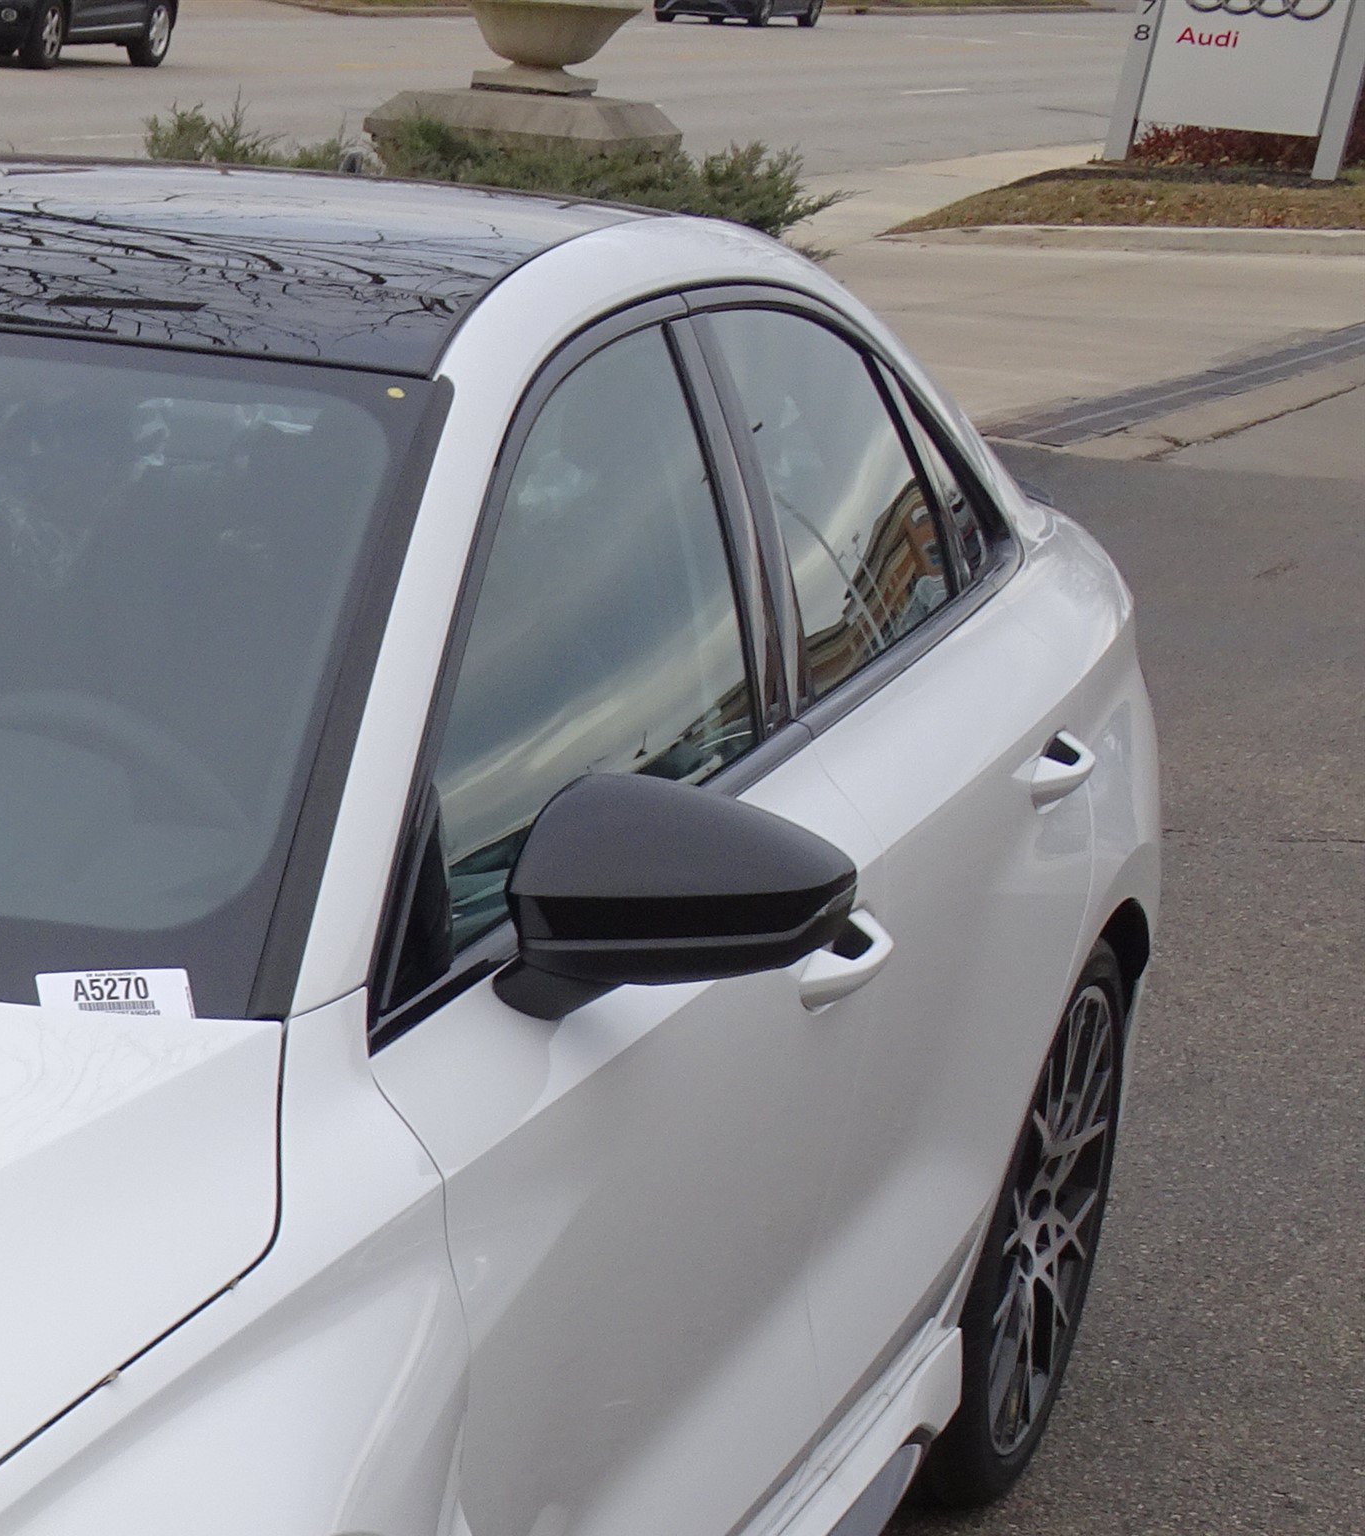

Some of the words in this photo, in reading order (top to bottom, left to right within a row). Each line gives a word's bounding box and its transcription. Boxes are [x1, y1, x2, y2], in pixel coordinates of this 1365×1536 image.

[1134, 24, 1151, 41] 8
[1176, 26, 1240, 48] Audi
[73, 976, 150, 1001] A5270
